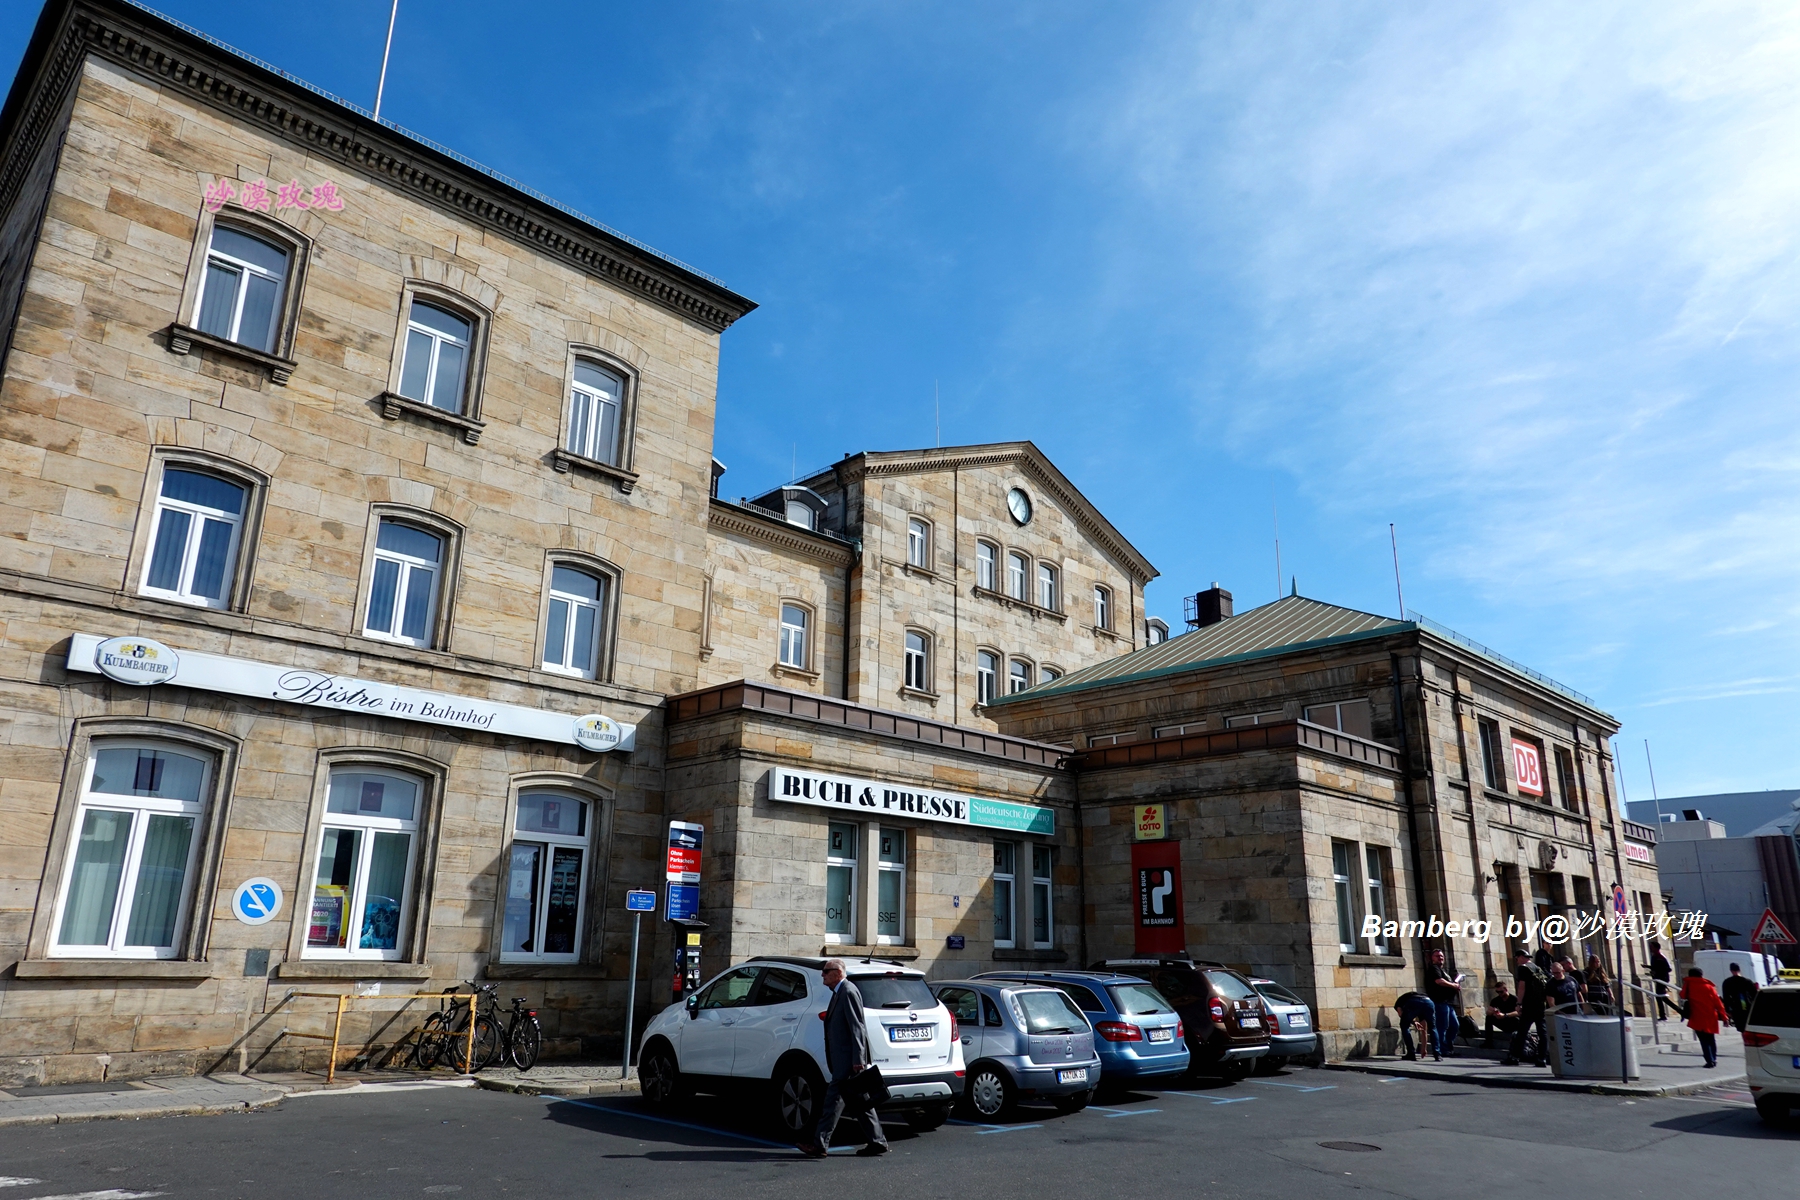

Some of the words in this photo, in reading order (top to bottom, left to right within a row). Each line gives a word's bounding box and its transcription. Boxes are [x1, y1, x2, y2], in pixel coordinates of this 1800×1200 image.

[103, 652, 169, 675] KULMBACHER
[272, 670, 383, 710] Bistro
[389, 697, 414, 714] im
[419, 701, 497, 729] Bahnhof
[577, 727, 617, 743] KULMBACHER
[1514, 747, 1539, 787] DB
[782, 774, 852, 804] BUCH
[858, 786, 877, 807] &
[883, 789, 966, 820] PRESSE
[972, 801, 1022, 819] Süddeutsche
[1022, 808, 1050, 826] Zeitung
[1138, 822, 1161, 832] LOTTO
[669, 856, 694, 865] Parkschein
[1150, 917, 1174, 925] BAHNHOF
[896, 1028, 907, 1039] ER
[910, 1027, 919, 1038] SB
[920, 1027, 929, 1038] 33
[1561, 1032, 1575, 1067] Abfall
